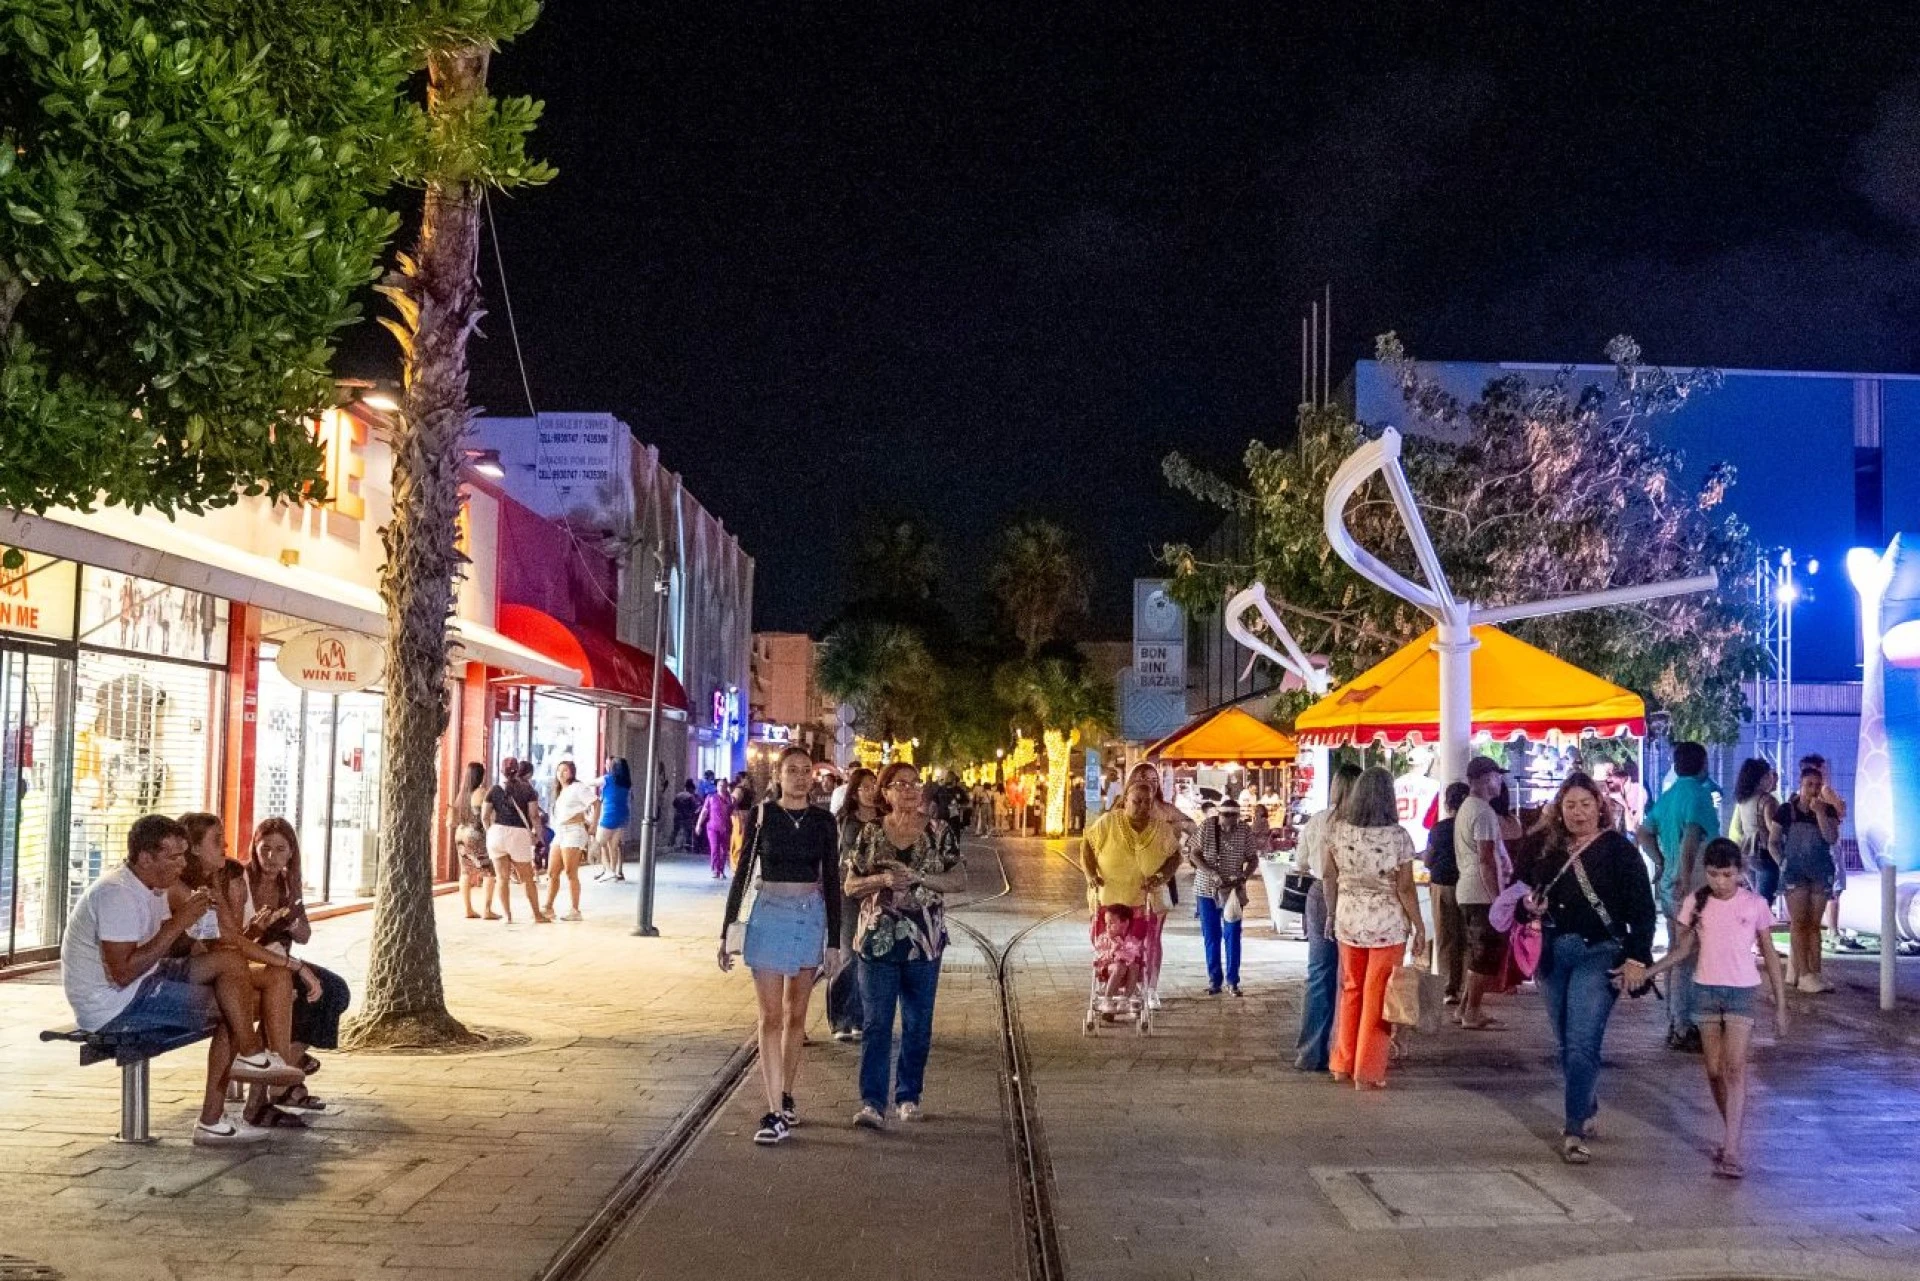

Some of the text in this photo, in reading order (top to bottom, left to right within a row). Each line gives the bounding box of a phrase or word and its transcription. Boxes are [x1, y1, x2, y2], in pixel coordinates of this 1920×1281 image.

[17, 605, 39, 629] ME
[1140, 647, 1167, 659] BON
[1140, 661, 1168, 673] BINI
[302, 668, 357, 682] WIN ME
[1140, 675, 1181, 687] BAZAR
[1397, 797, 1418, 819] 21
